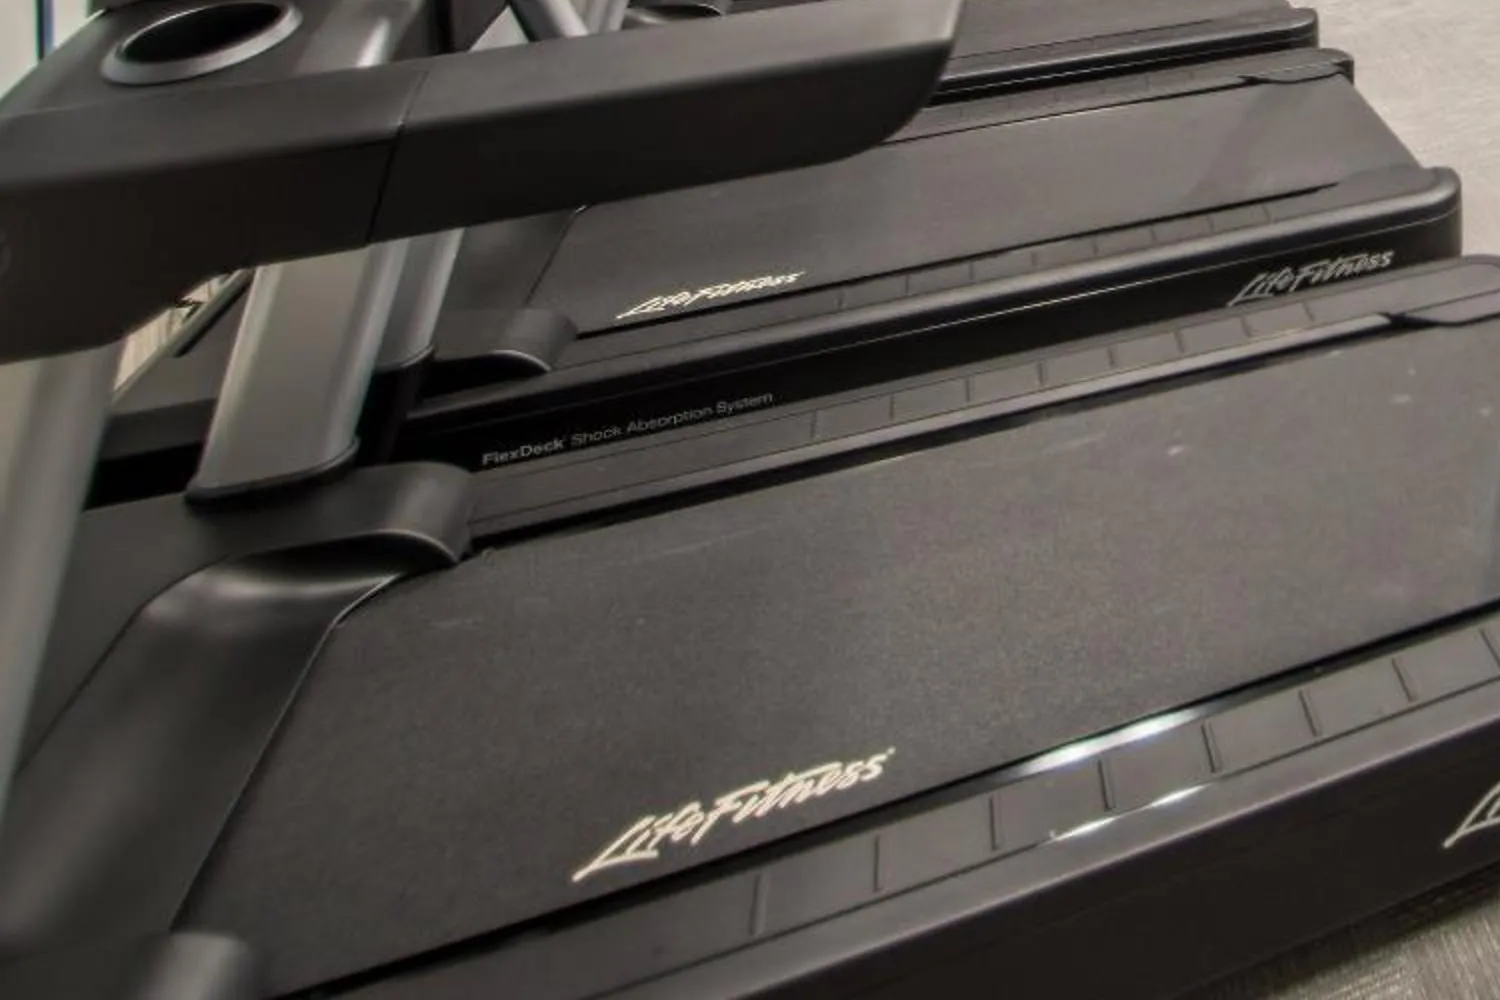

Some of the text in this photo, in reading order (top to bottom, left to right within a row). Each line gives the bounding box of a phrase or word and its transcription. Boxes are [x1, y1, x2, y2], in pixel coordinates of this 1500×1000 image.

[481, 392, 774, 467] FlexDeck Shock Absorption System
